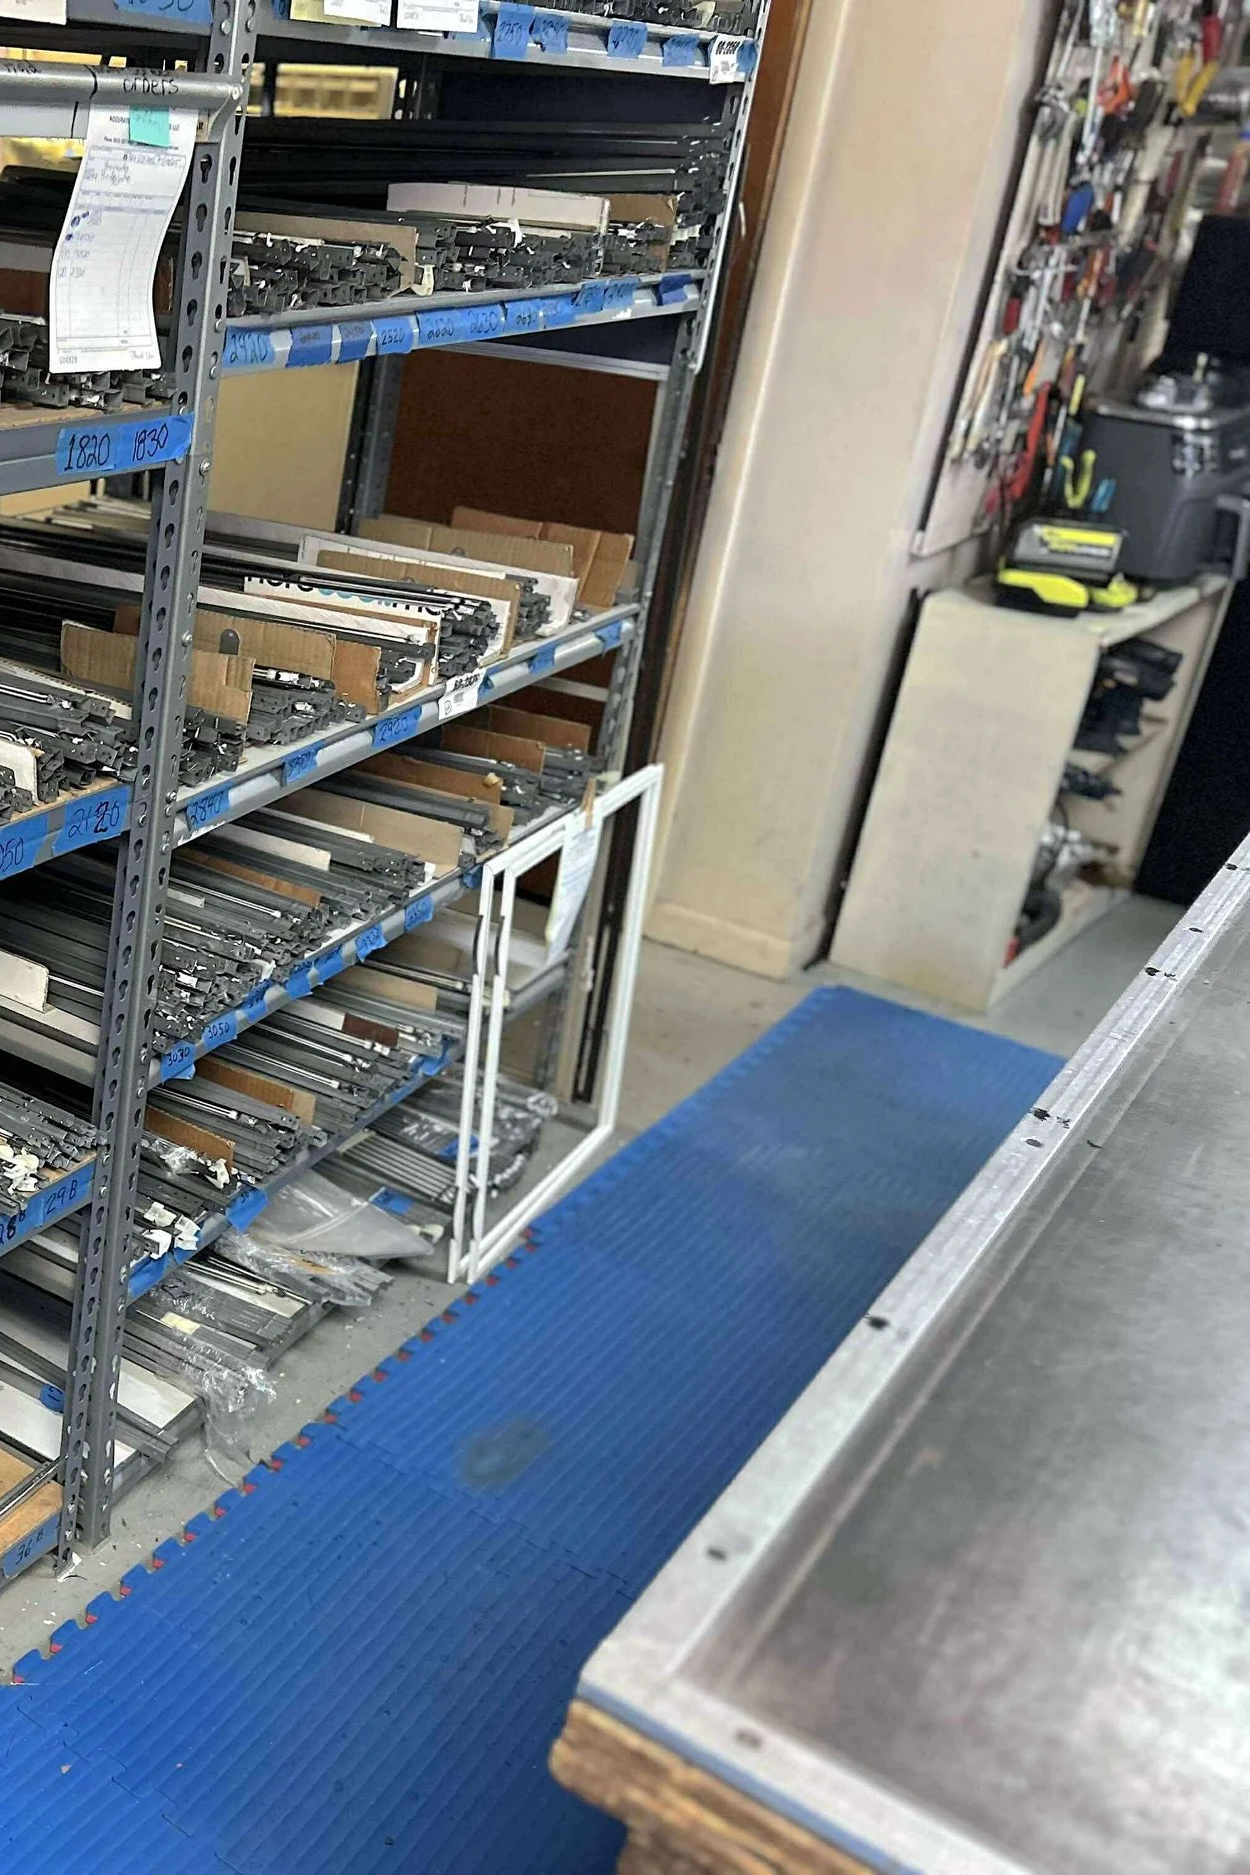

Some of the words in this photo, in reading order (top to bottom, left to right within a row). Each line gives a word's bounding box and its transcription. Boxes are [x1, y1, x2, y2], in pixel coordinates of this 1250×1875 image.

[63, 433, 111, 472] 1820
[132, 422, 169, 462] 1830
[207, 1020, 231, 1041] 3050
[166, 1045, 192, 1067] 3030
